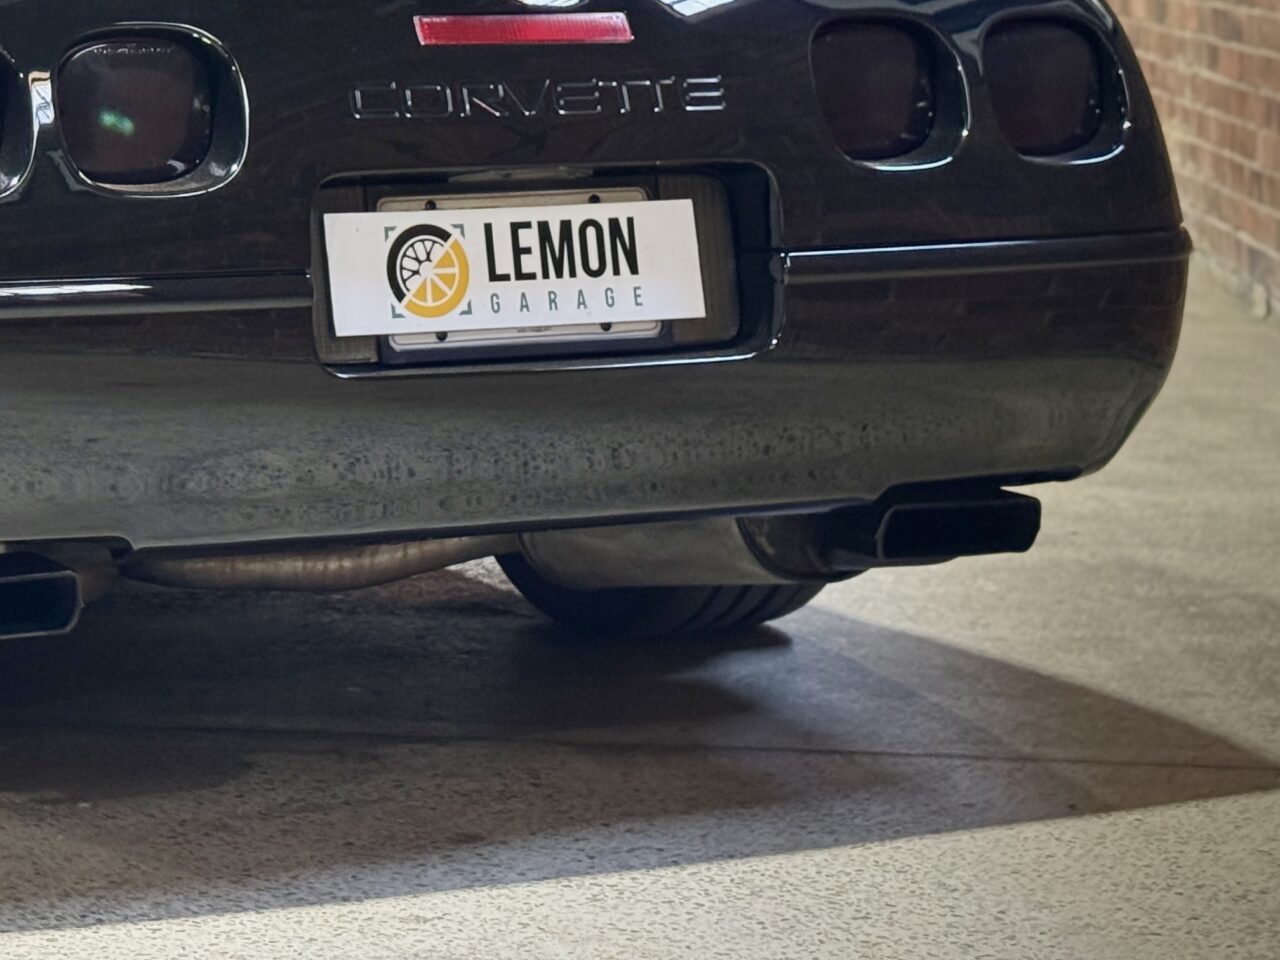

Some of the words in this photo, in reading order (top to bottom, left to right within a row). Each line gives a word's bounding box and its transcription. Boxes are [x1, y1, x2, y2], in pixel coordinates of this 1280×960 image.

[351, 75, 726, 118] CORVETTE
[483, 216, 640, 282] LEMON
[490, 286, 644, 314] GARAGE
